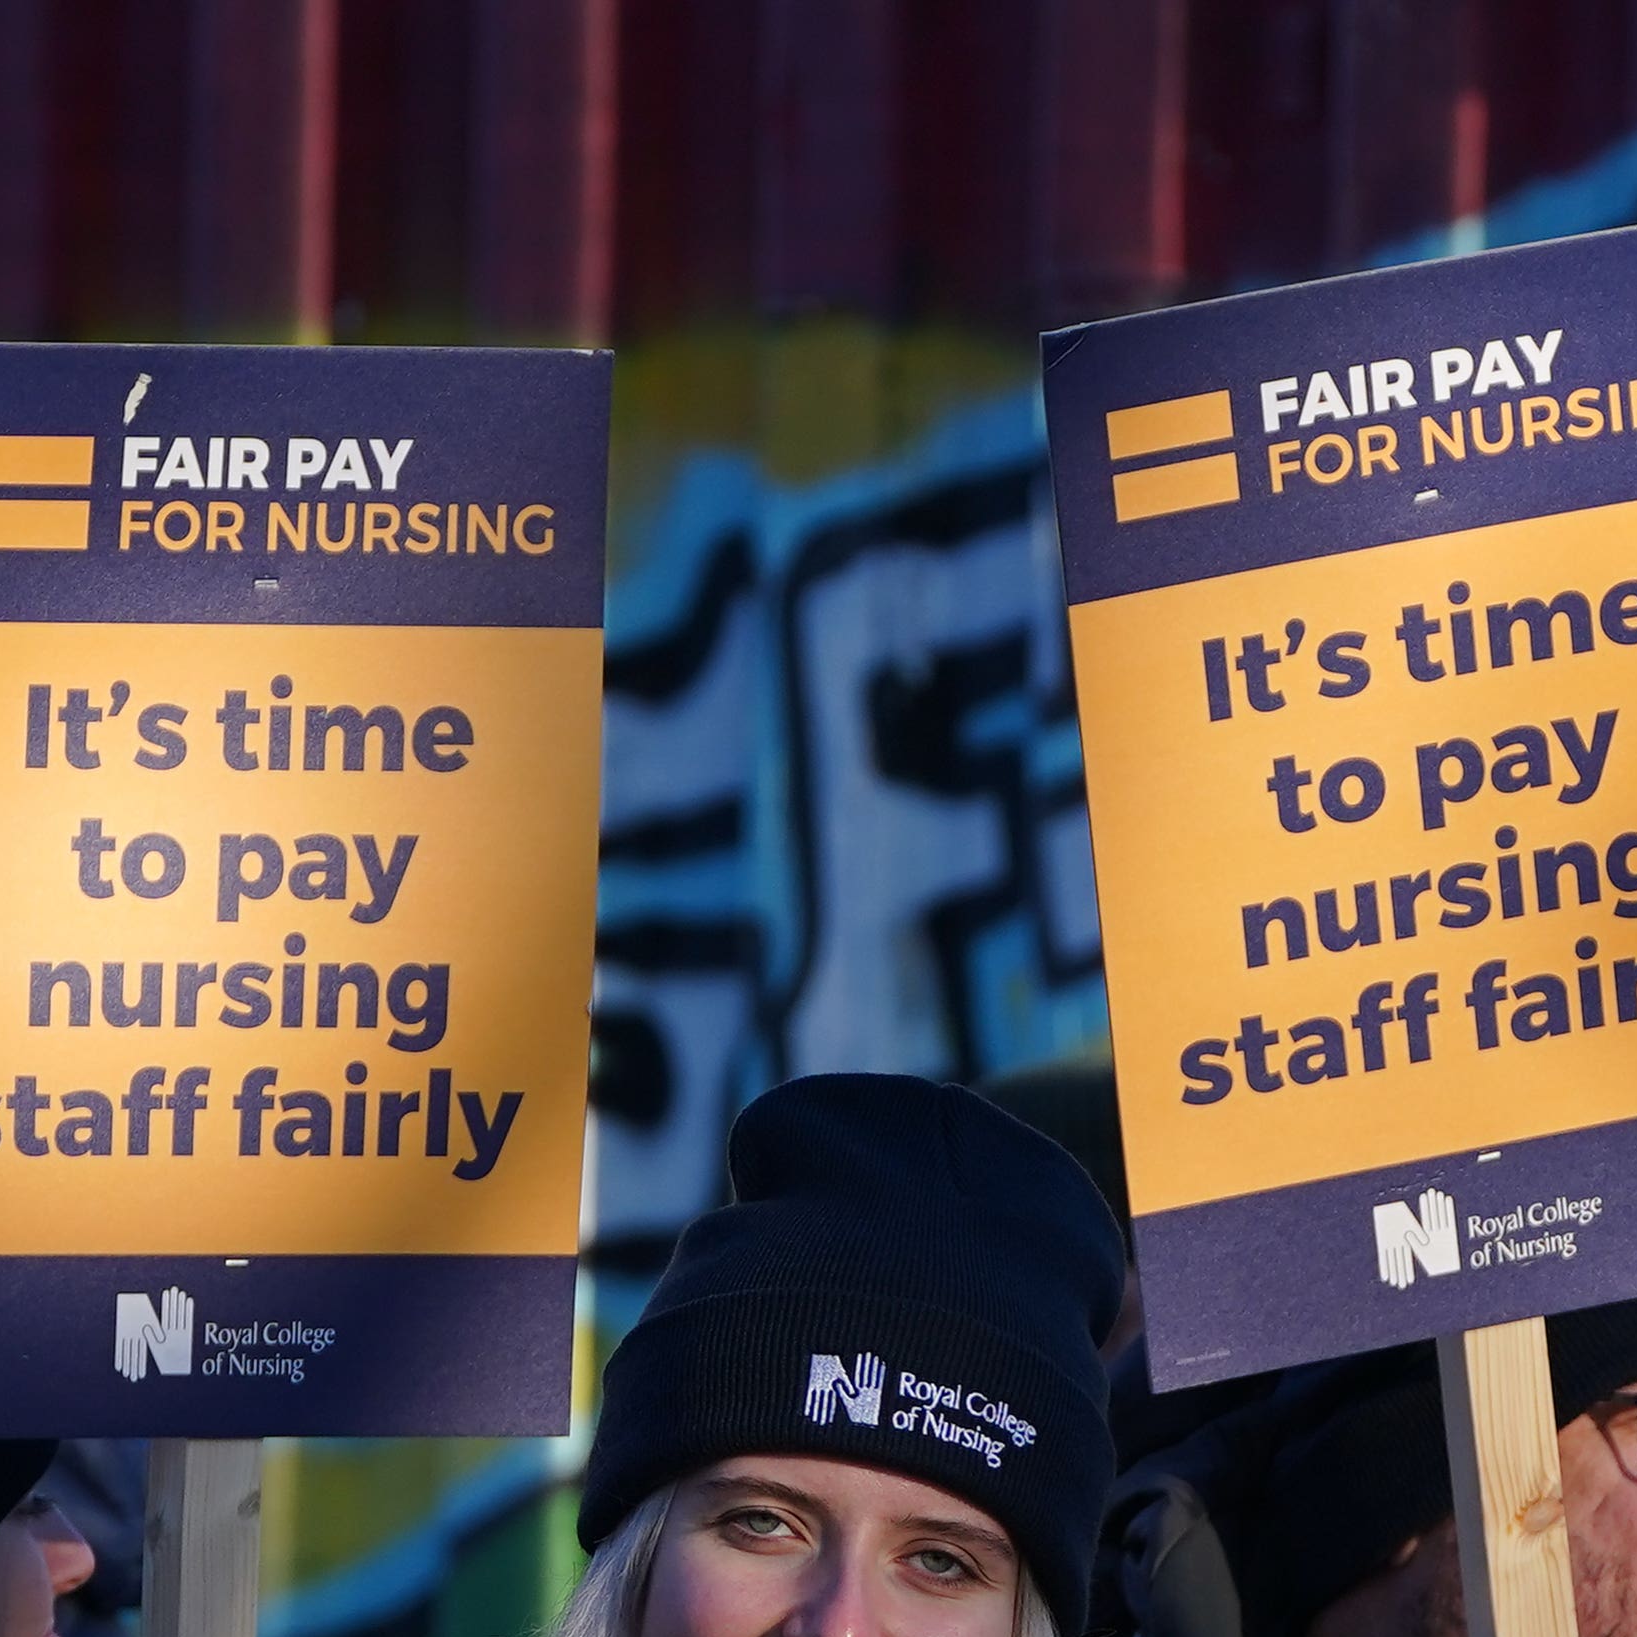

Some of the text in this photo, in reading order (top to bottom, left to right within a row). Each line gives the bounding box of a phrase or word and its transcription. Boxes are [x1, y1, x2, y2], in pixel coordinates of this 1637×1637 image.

[1260, 329, 1563, 433] FAIR PAY
[121, 436, 414, 491] FAIR PAY
[1268, 424, 1401, 494] FOR
[119, 500, 554, 555] FOR NURSING
[1202, 618, 1371, 723] It's
[25, 674, 475, 774] It's time
[1266, 709, 1619, 834] to pay
[71, 818, 420, 925] to pay
[28, 932, 451, 1054] nursing
[1179, 972, 1440, 1106] staff
[233, 1062, 526, 1183] fairly
[1467, 1193, 1603, 1241] Royal College
[1471, 1226, 1579, 1268] of Nursing
[201, 1351, 305, 1384] of Nursing
[204, 1320, 336, 1353] Royal College
[892, 1406, 1005, 1469] of Nursing
[898, 1371, 1037, 1448] Royal College
